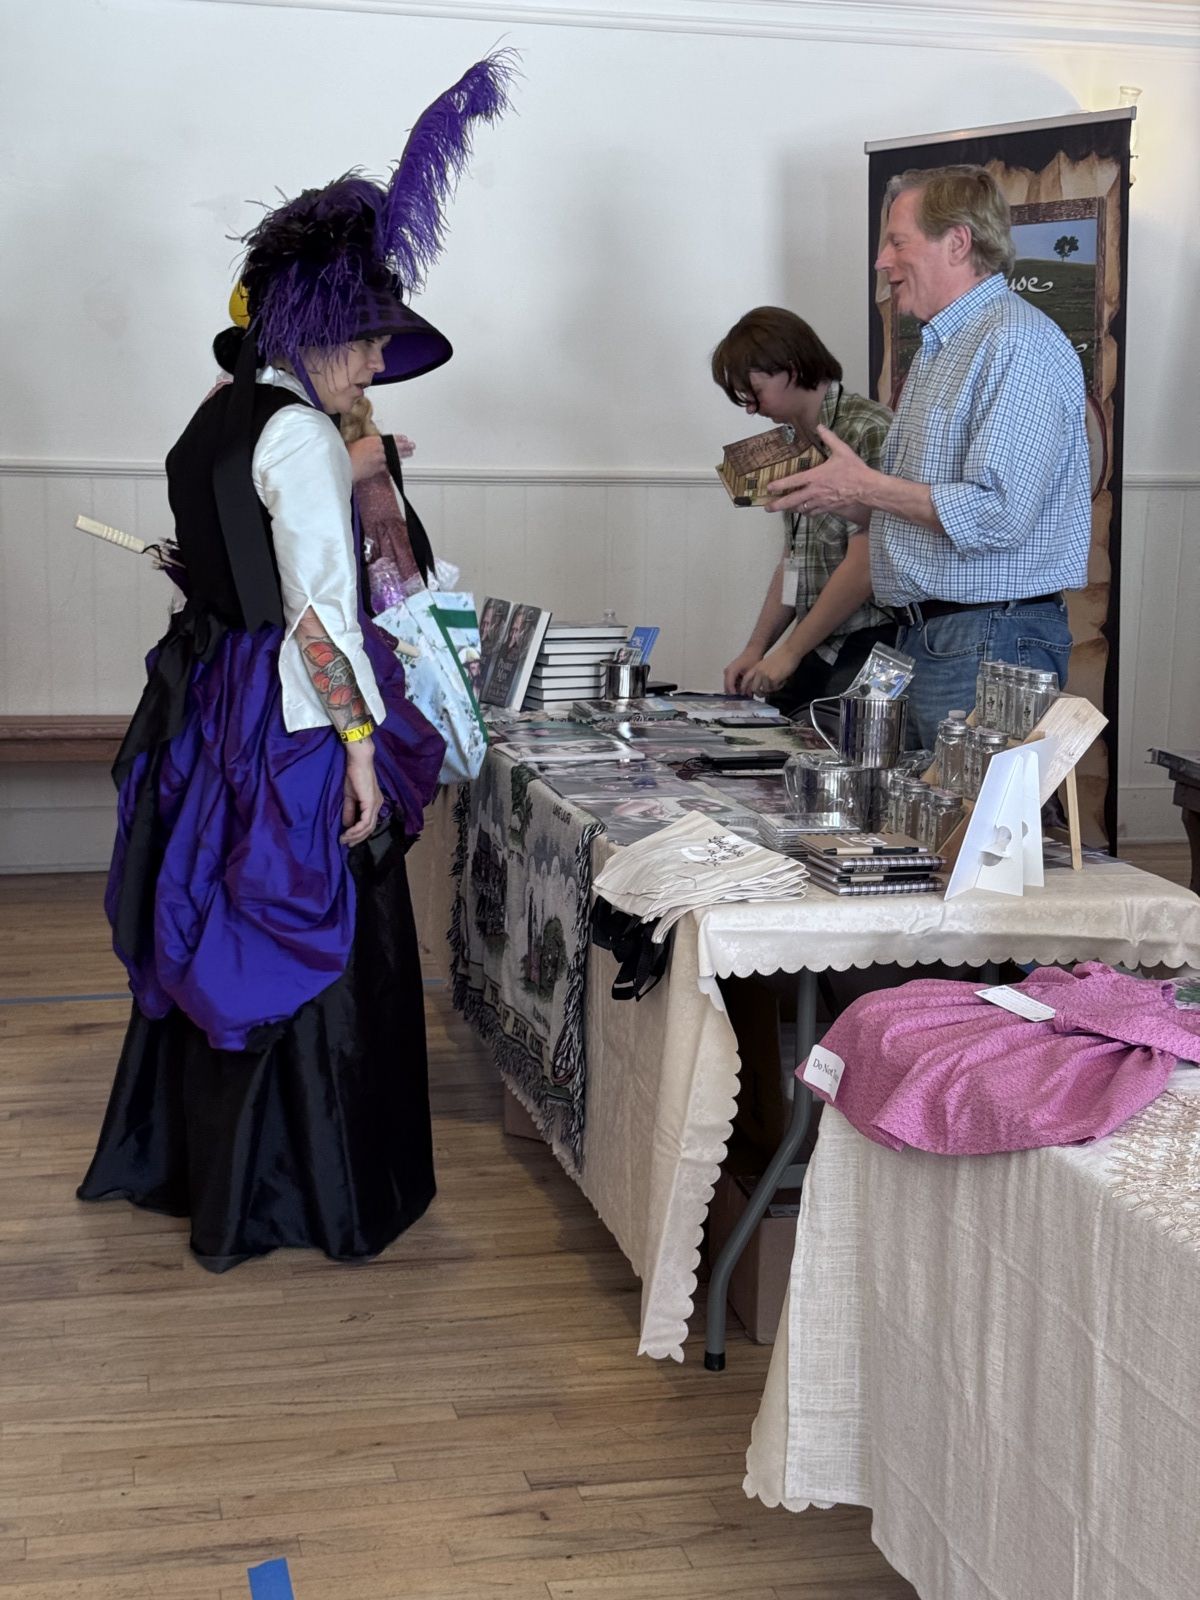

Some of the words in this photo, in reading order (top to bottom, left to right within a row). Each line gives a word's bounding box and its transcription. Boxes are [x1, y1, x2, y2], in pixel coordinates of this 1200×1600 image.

[1006, 276, 1054, 293] use
[812, 1058, 823, 1071] Do
[823, 1063, 835, 1077] Not
